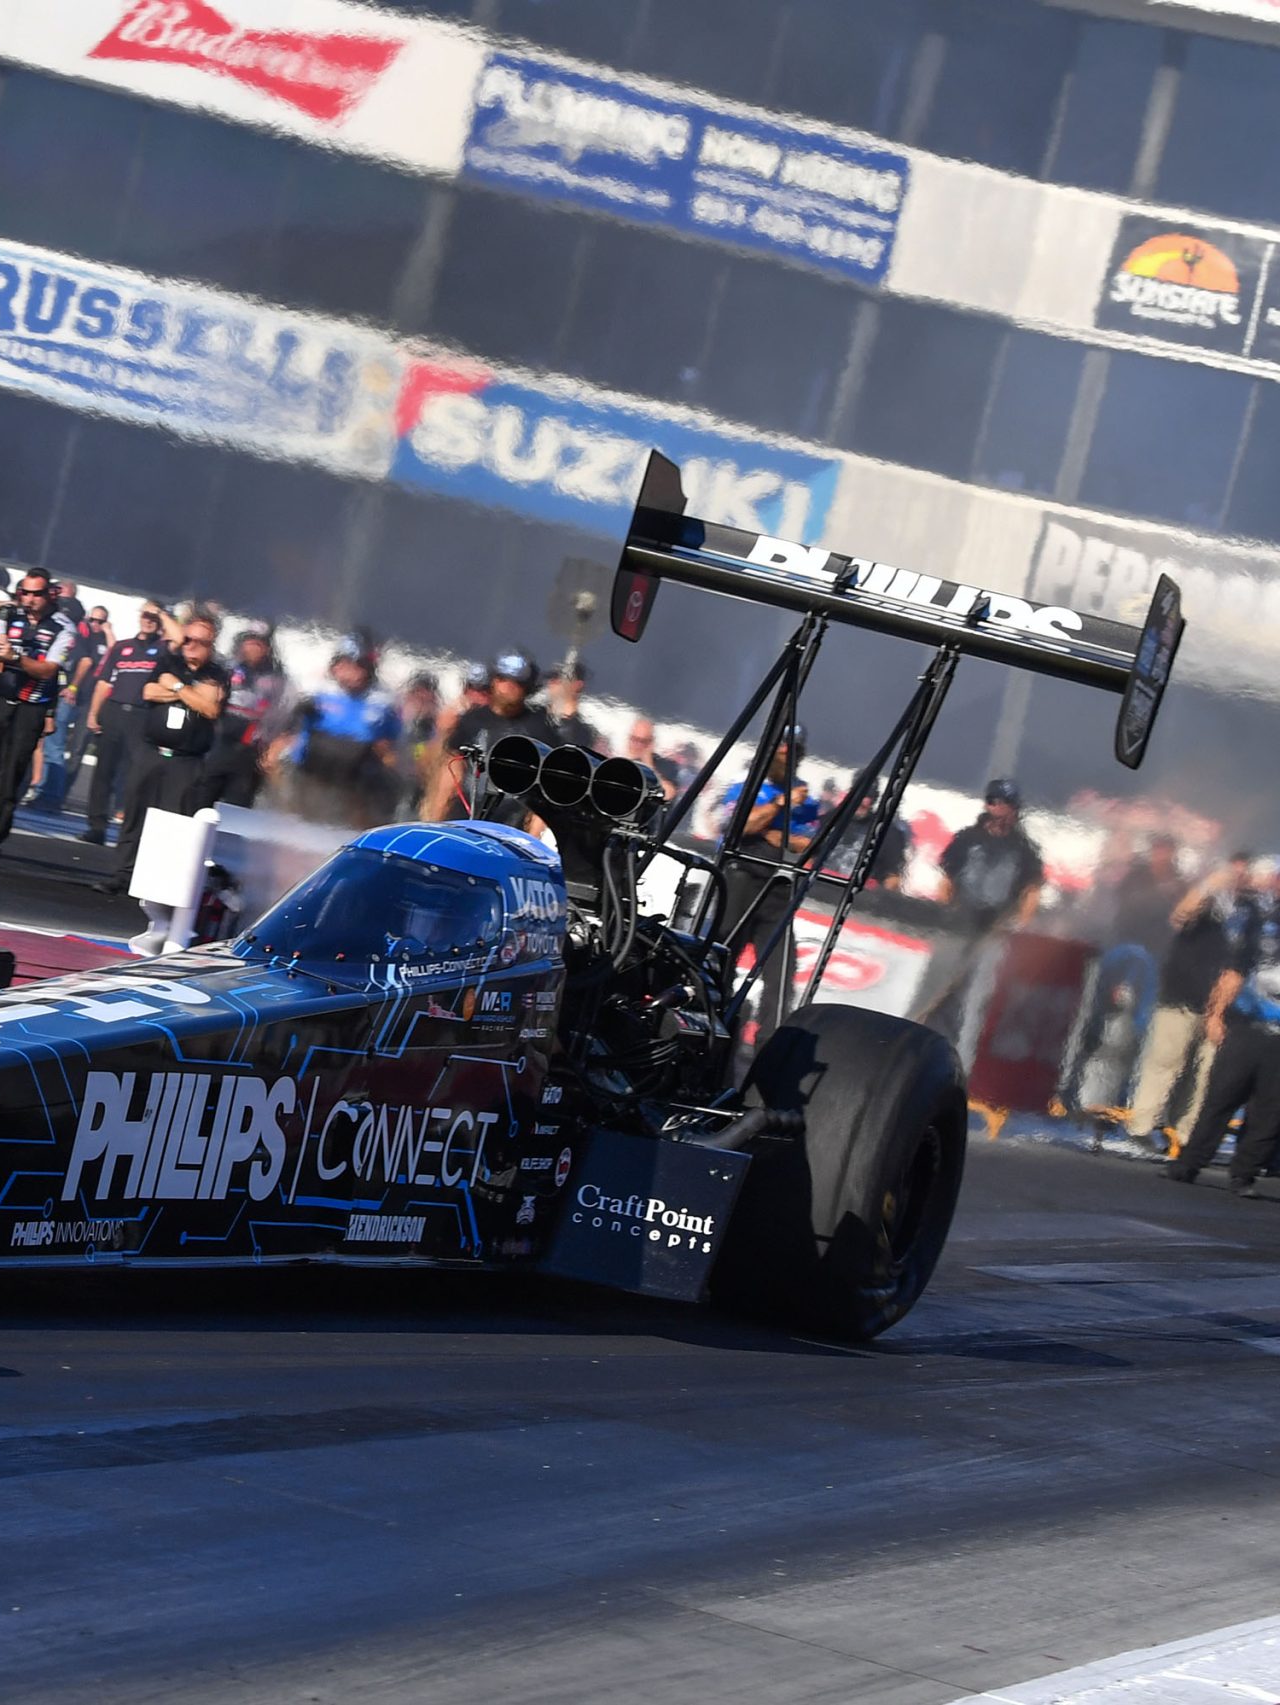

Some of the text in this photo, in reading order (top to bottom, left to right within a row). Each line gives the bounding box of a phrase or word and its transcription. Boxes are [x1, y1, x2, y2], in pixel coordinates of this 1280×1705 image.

[526, 932, 561, 955] TOYOTA
[61, 1071, 500, 1202] PHILLIPS CONNECT
[577, 1184, 715, 1235] CraftPoint
[10, 1220, 56, 1247] PHILLIPS
[345, 1214, 427, 1242] HENDRICKSON
[572, 1212, 711, 1253] concepts
